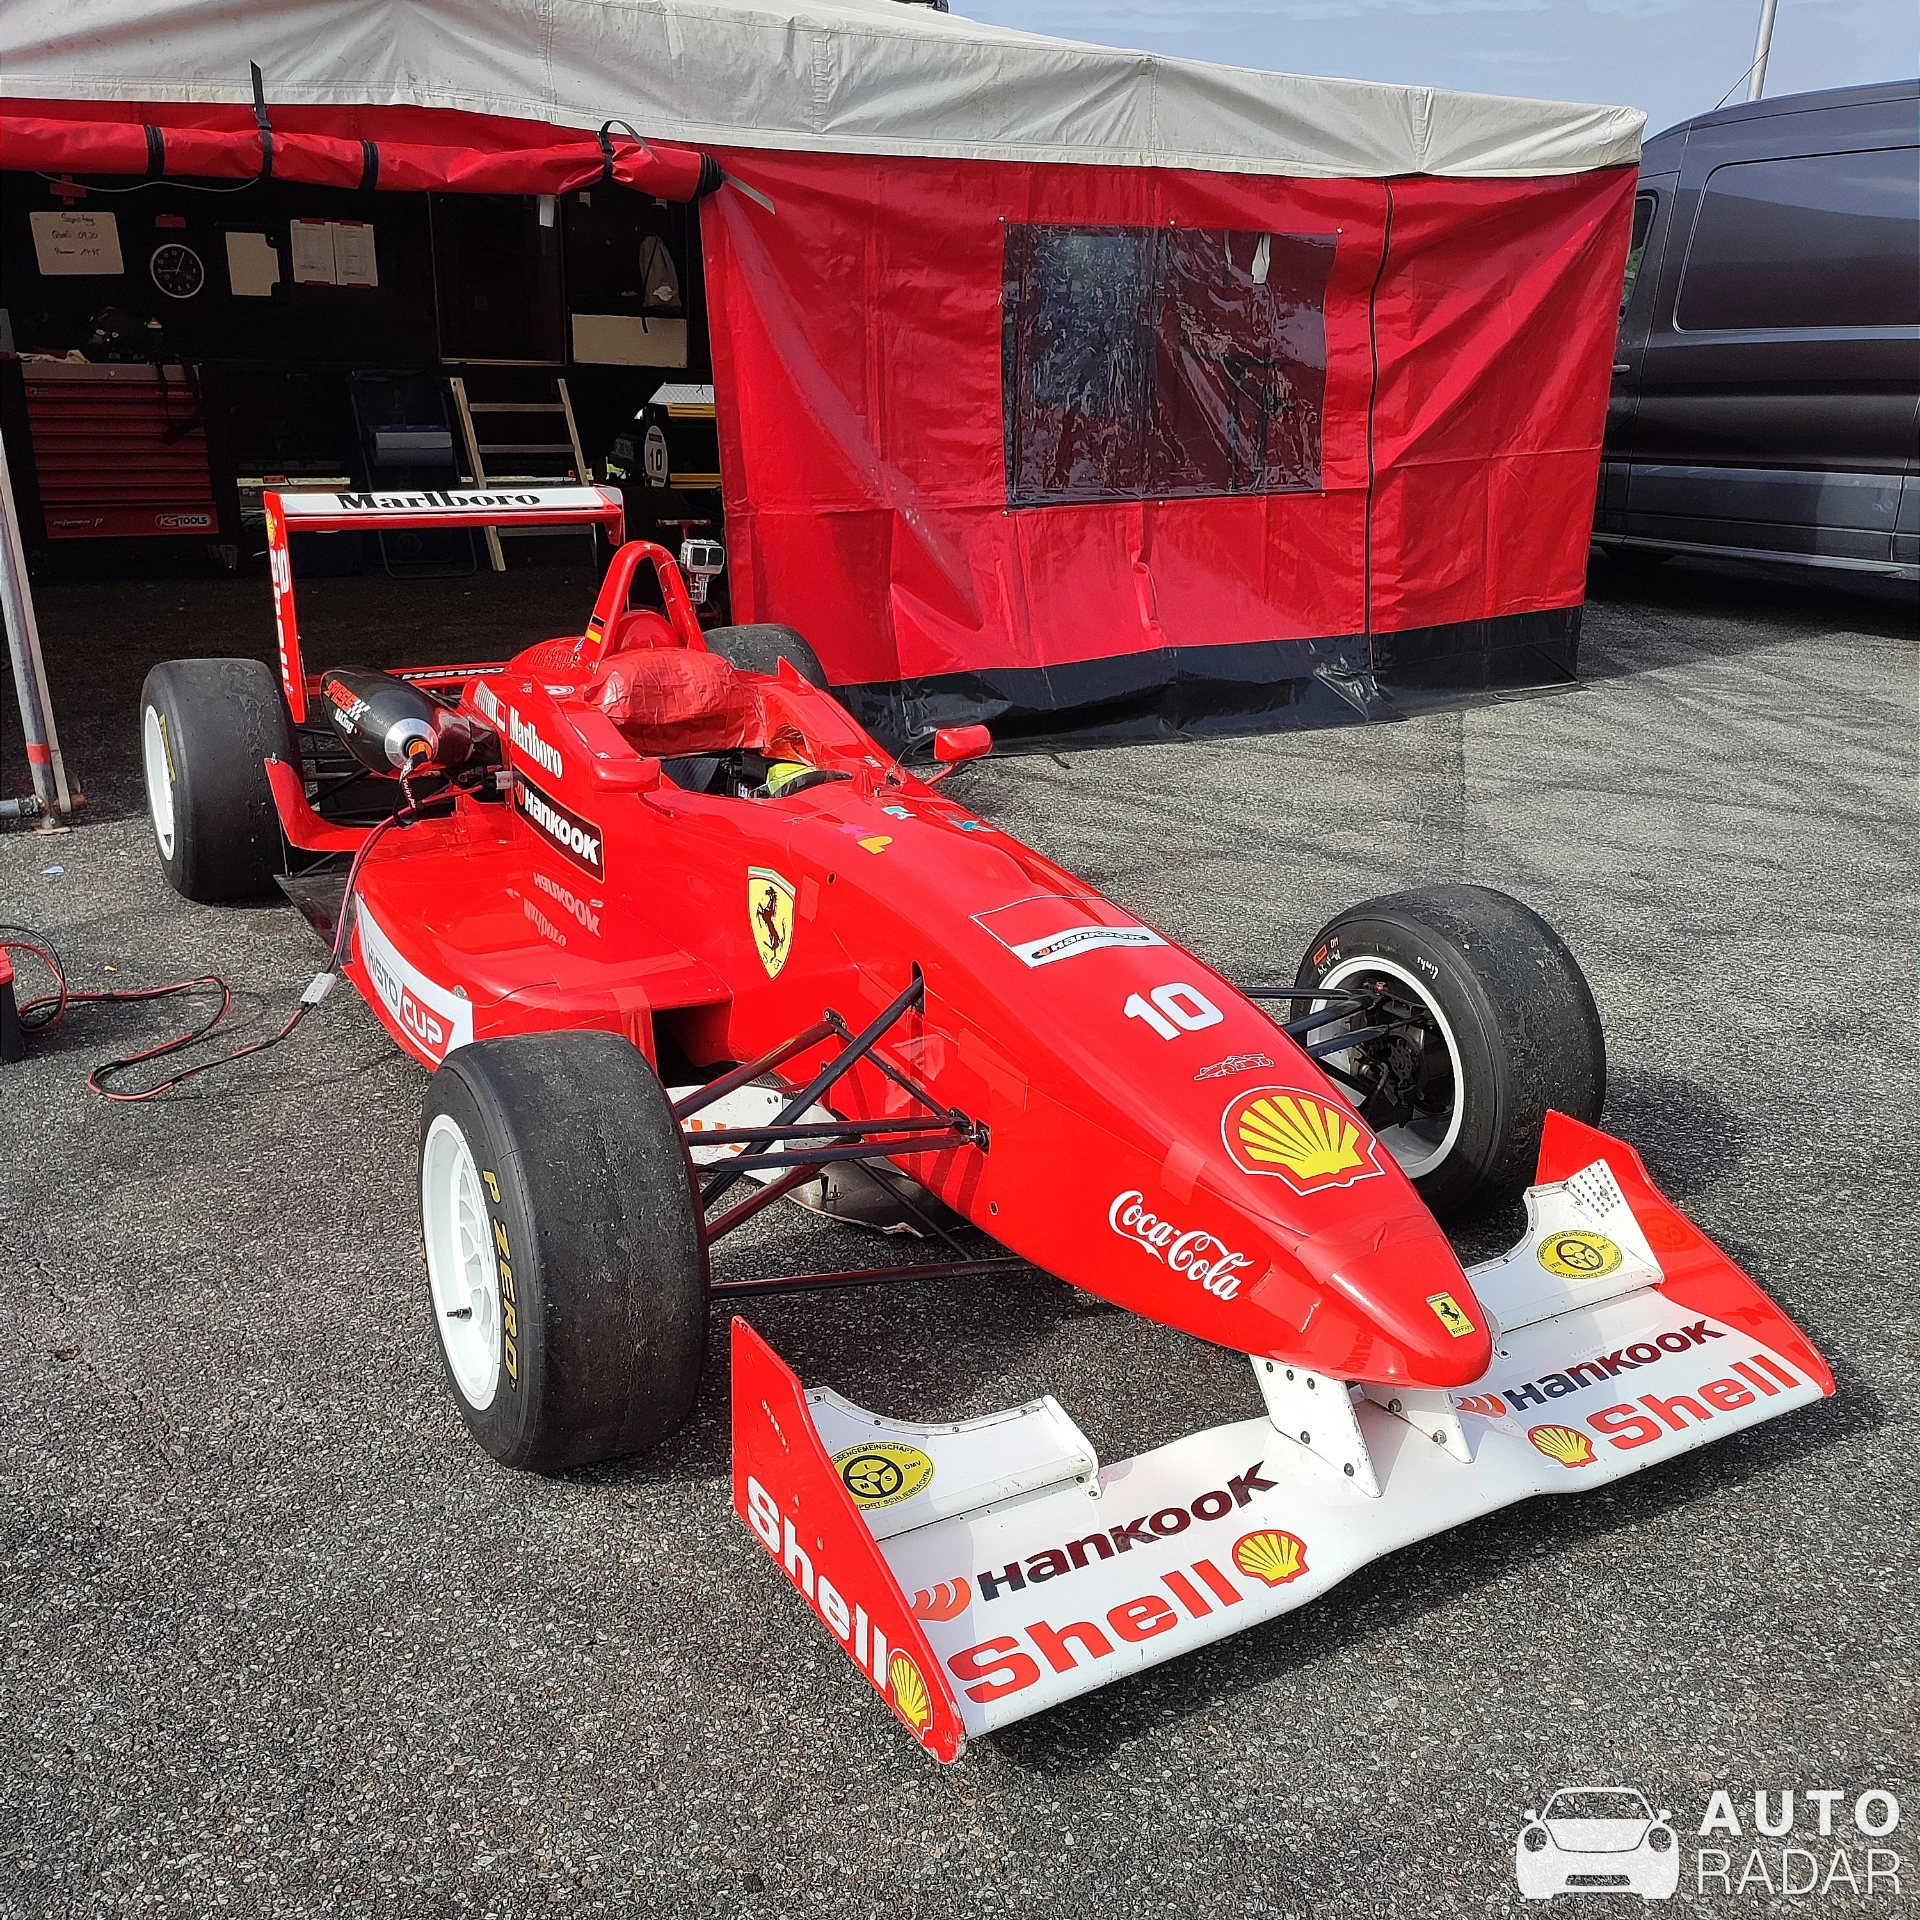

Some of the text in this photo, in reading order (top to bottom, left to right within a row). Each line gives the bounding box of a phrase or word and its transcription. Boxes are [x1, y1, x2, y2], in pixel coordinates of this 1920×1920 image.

[650, 448, 662, 472] 10
[179, 516, 208, 527] TOOLS
[336, 490, 541, 510] Marlboro
[510, 705, 564, 780] Marlboro
[366, 941, 444, 1046] HISTO CUP
[1123, 981, 1225, 1042] 10
[482, 1170, 518, 1381] P ZERO
[1108, 1189, 1254, 1302] Coca-Cola
[1585, 1353, 1802, 1450] Shell
[832, 1444, 915, 1464] SSENGEMEINSCHAFT
[904, 1460, 921, 1470] DMV
[860, 1482, 870, 1490] M
[883, 1467, 931, 1504] SCHLIERBACHTAL
[747, 1474, 890, 1687] Shell
[946, 1558, 1243, 1705] Shell
